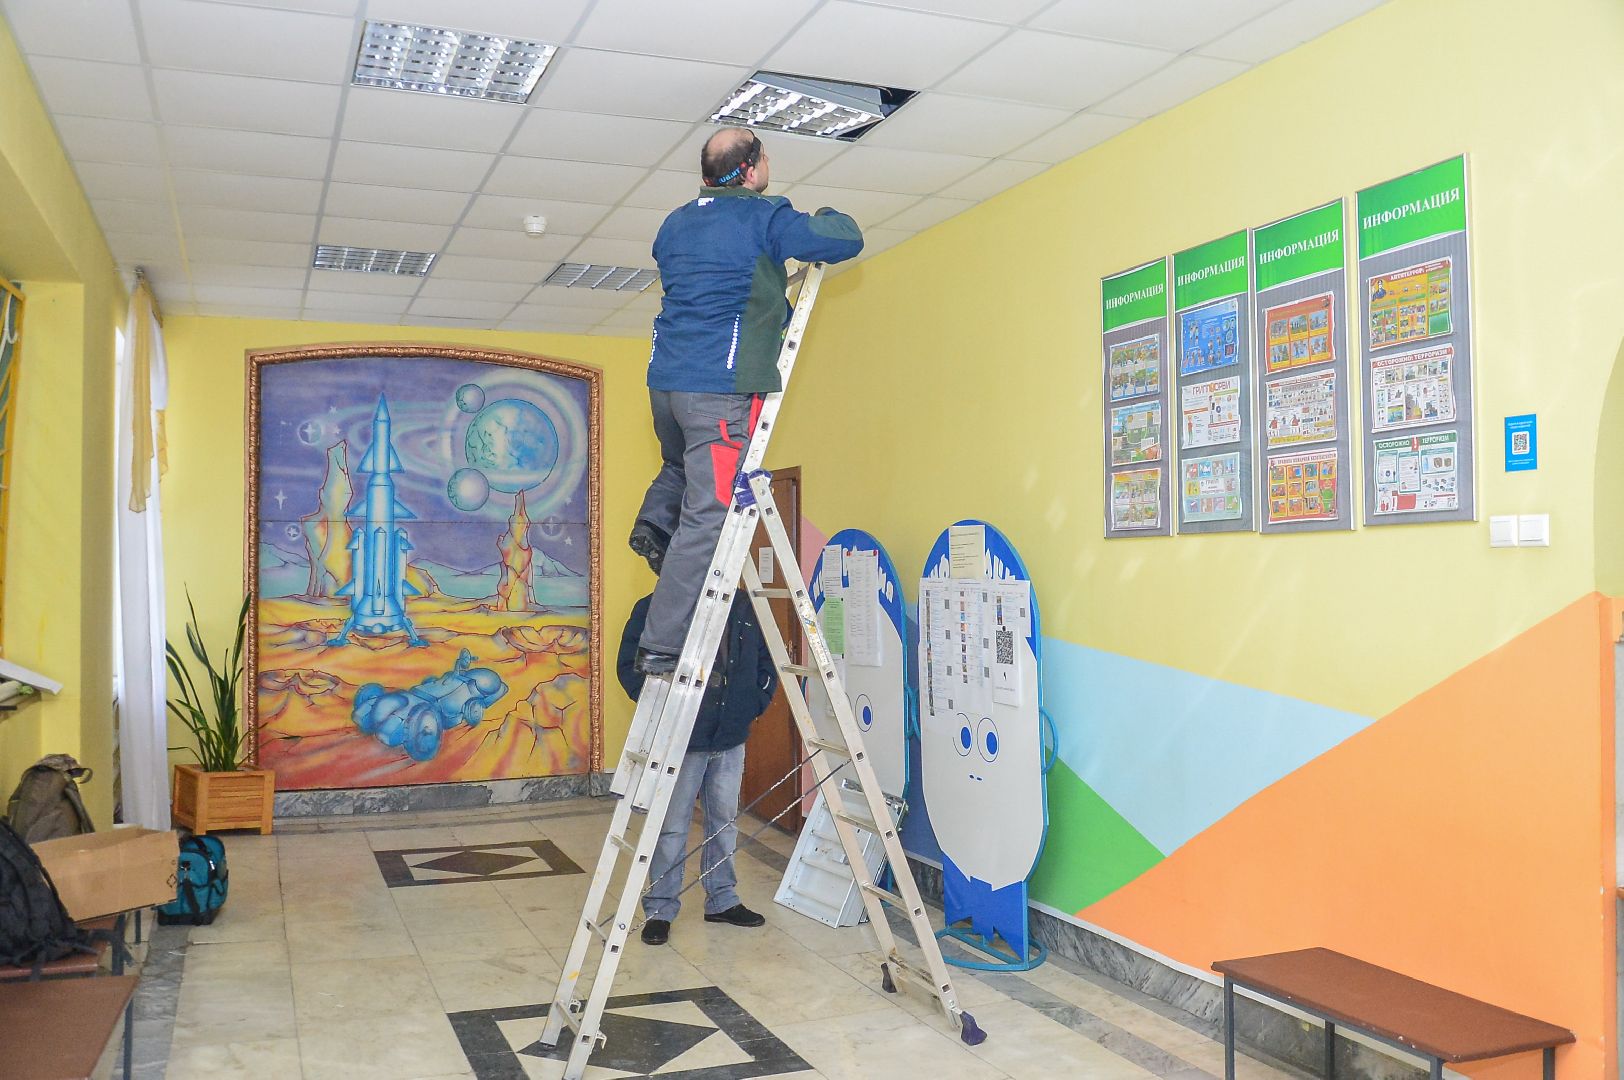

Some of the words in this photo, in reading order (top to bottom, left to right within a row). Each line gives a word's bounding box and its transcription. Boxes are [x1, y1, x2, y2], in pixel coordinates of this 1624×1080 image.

[1363, 187, 1460, 230] ИНФОРМАЦИЯ
[1259, 229, 1339, 264] ИНФОРМАЦИЯ
[1177, 256, 1245, 286] ИНФОРМАЦИЯ
[1105, 283, 1164, 310] ИНФОРМАЦИЯ
[1378, 440, 1410, 449] ОСТОРОЖНО
